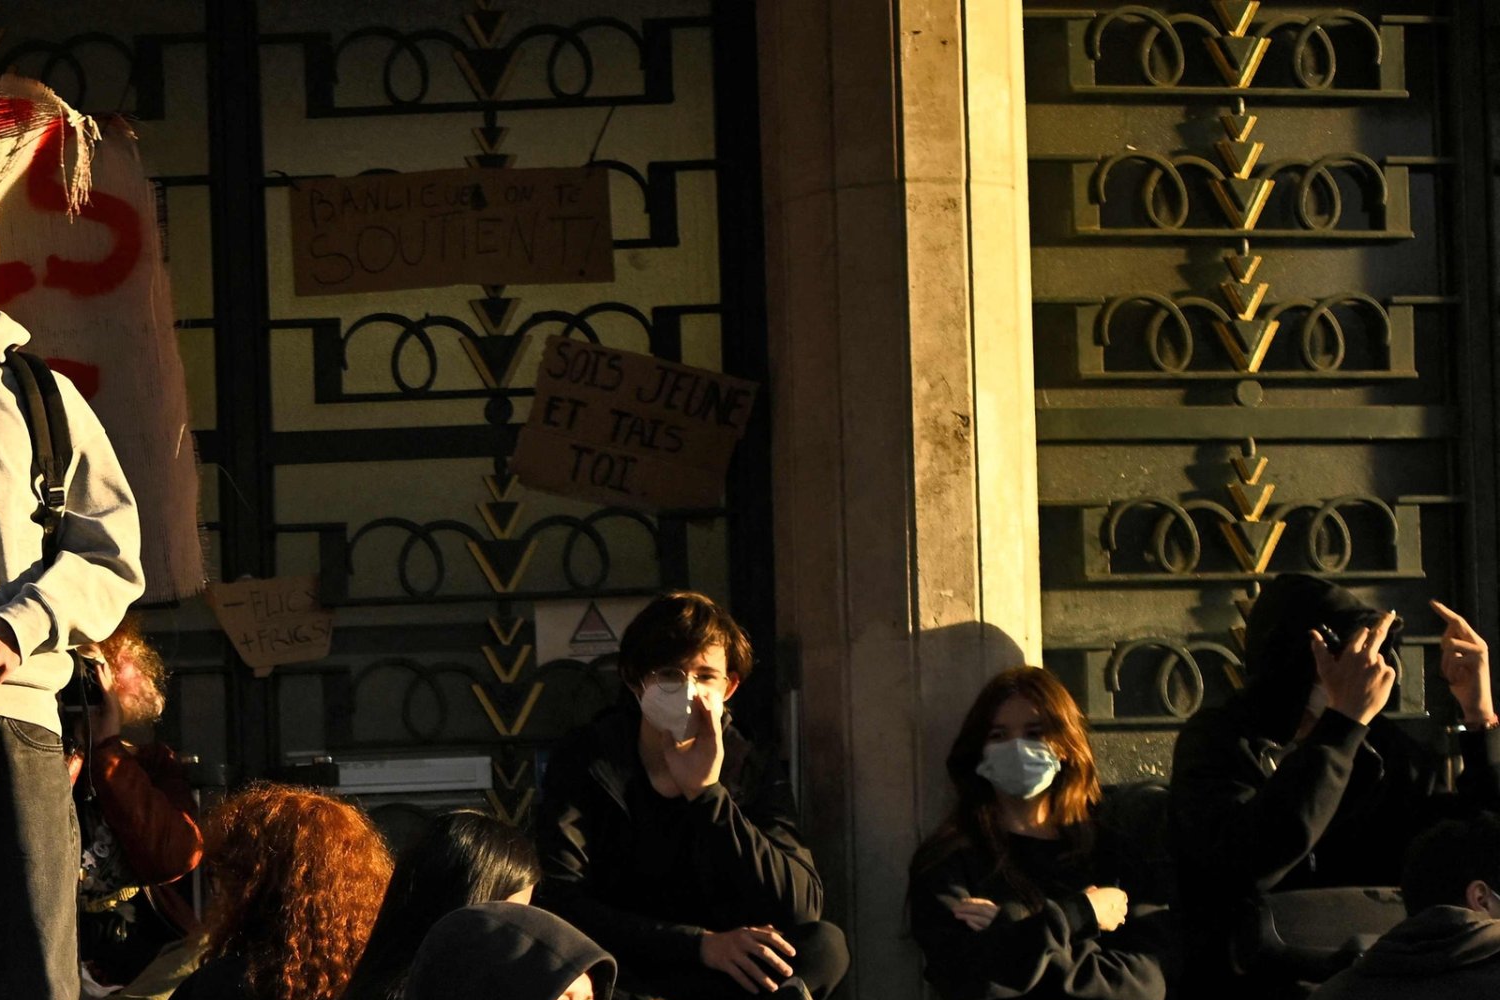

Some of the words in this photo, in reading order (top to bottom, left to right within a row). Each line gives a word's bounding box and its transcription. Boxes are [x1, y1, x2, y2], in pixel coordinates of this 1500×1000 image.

[504, 184, 533, 206] ON
[554, 184, 582, 207] TE
[547, 341, 624, 391] SOIS
[636, 365, 751, 429] JEUNE
[543, 395, 588, 430] ET
[609, 408, 687, 453] TAIS
